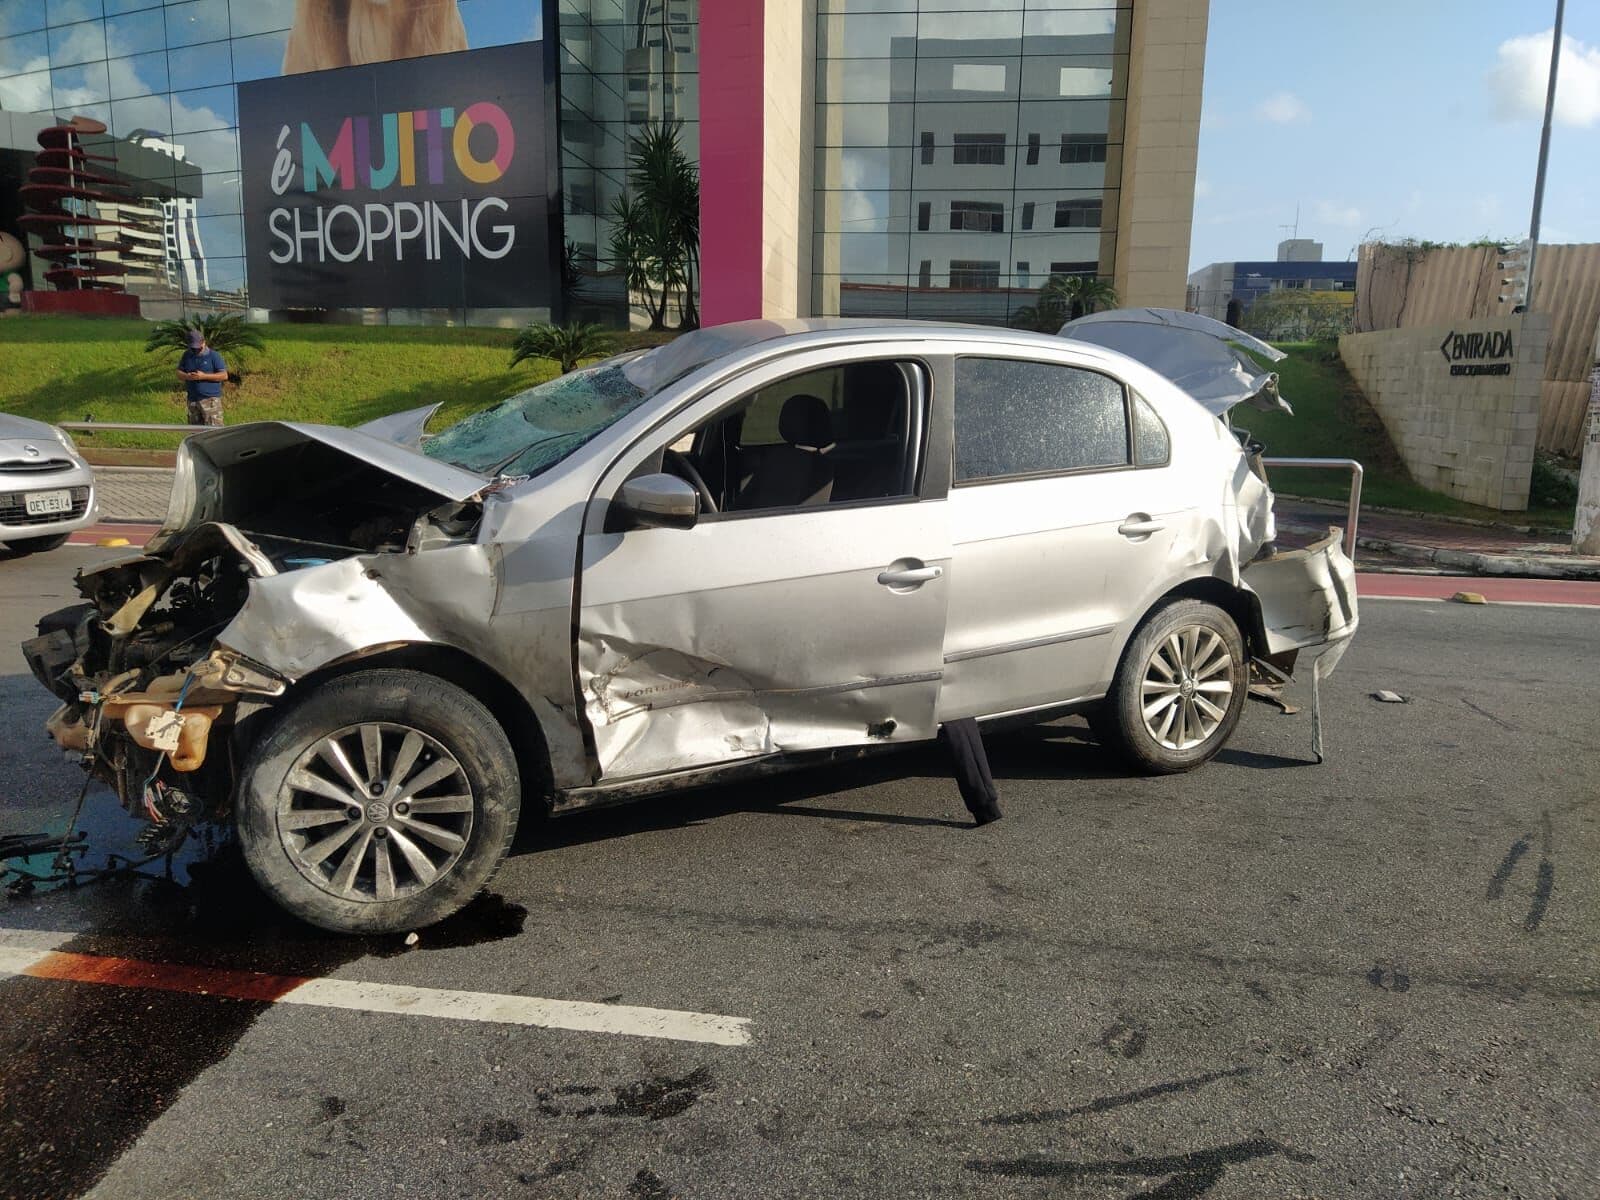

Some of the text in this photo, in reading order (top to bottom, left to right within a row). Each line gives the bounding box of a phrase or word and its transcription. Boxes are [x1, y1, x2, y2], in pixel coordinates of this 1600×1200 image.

[271, 101, 515, 196] é MUITO
[269, 197, 515, 264] SHOPPING
[1452, 329, 1513, 360] ENTRADA
